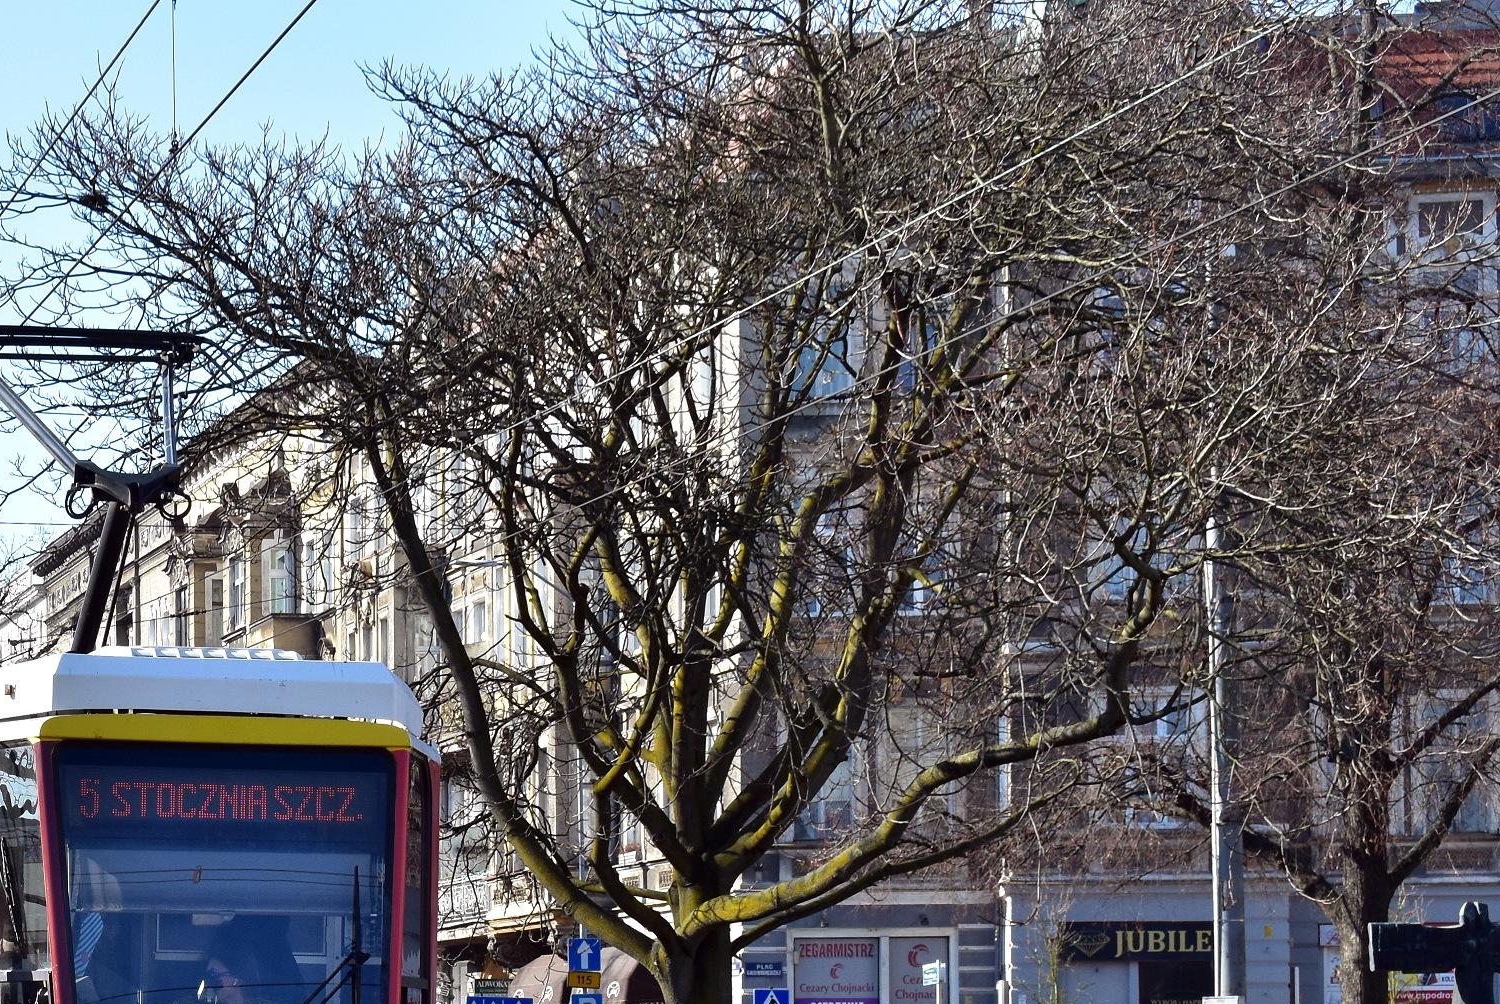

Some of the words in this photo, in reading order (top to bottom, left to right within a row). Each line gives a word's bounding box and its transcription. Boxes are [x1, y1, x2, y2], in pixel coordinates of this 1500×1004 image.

[79, 778, 100, 818] 5
[111, 781, 268, 821] STOCZNIA
[273, 785, 364, 823] SZCZ.
[799, 943, 875, 958] ZEGARMISTRZ
[576, 975, 593, 985] 115
[799, 983, 828, 994] Cezary
[831, 982, 875, 994] Chojnacki
